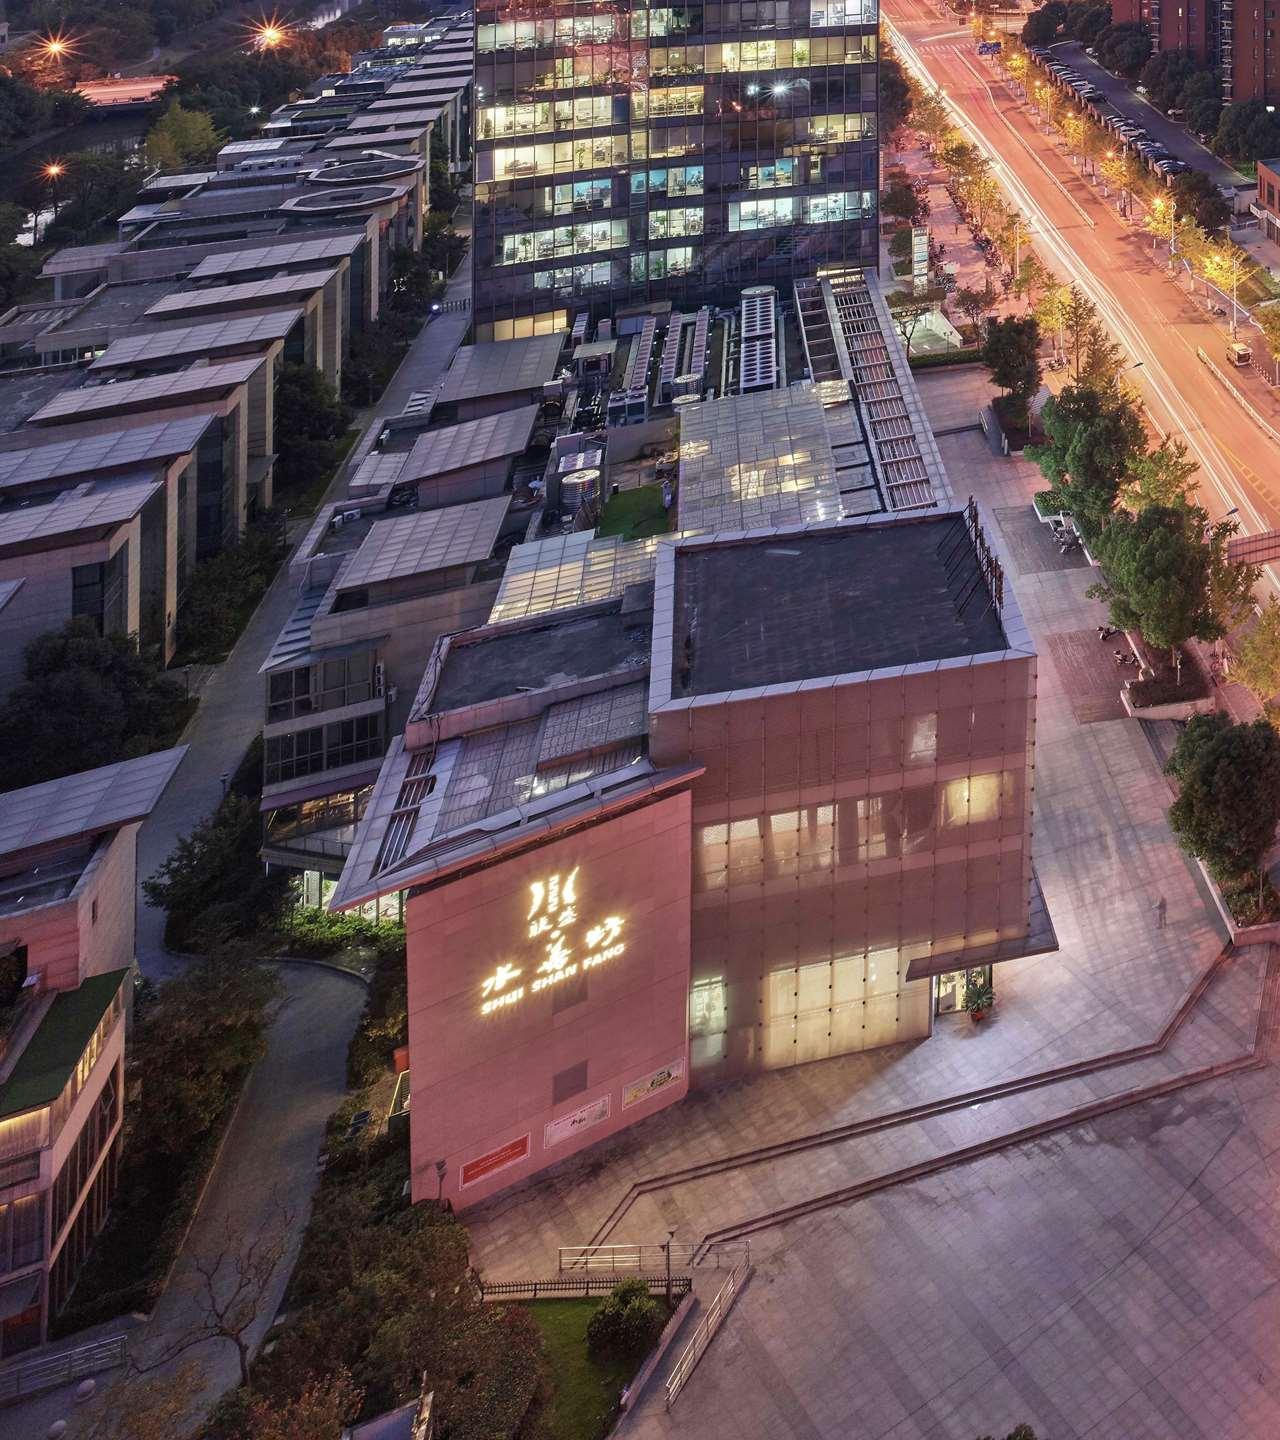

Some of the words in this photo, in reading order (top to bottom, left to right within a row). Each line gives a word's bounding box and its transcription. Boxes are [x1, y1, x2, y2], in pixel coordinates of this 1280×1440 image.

[481, 986, 525, 1015] SHUI
[531, 963, 578, 993] SHAN
[583, 943, 626, 970] FANG
